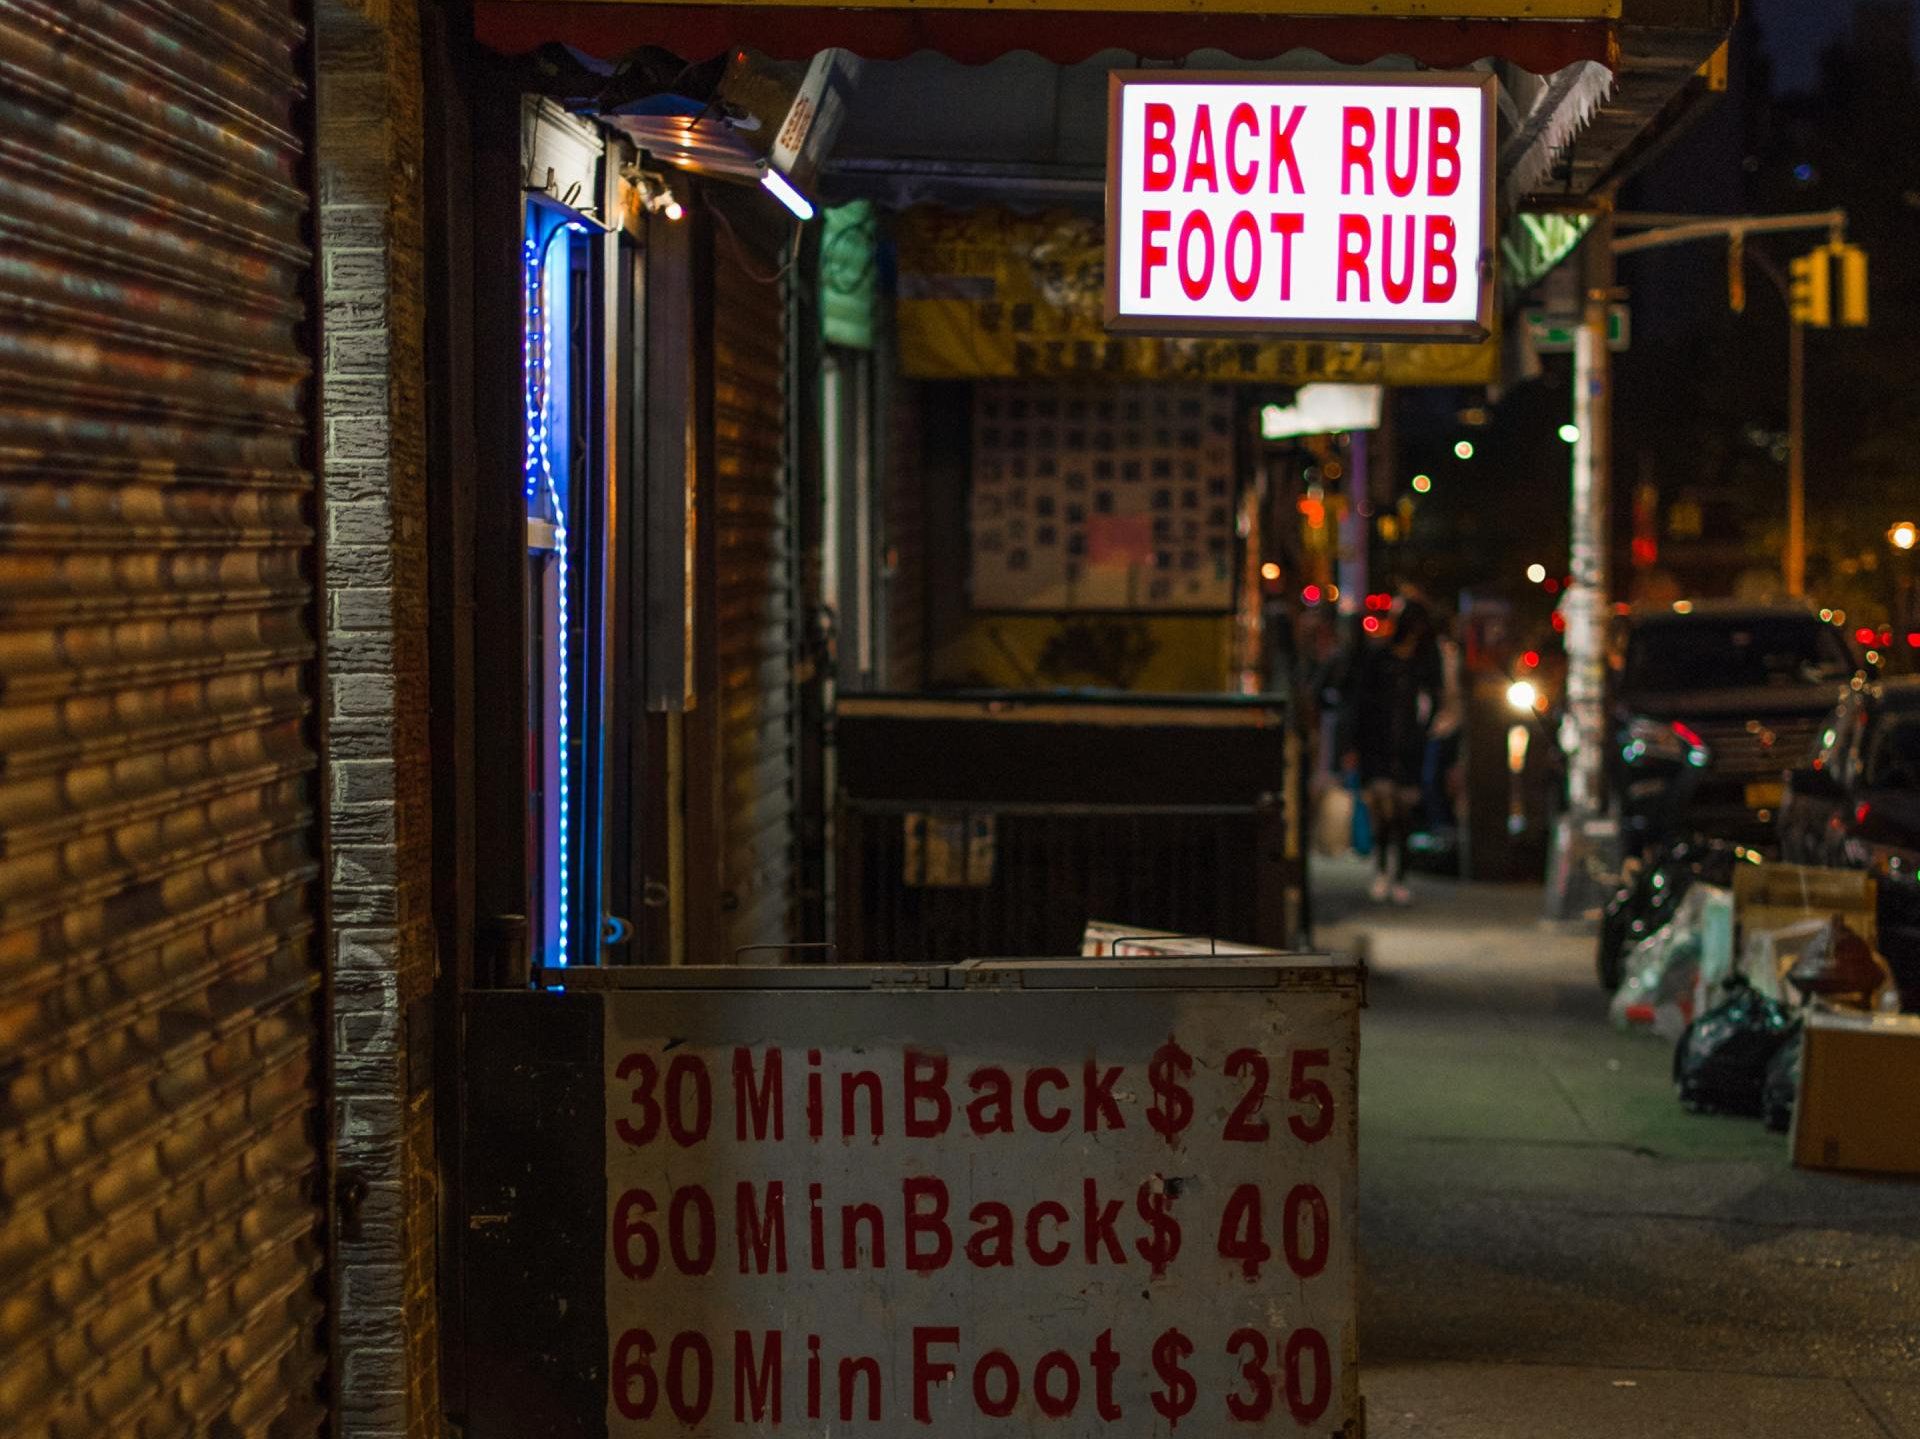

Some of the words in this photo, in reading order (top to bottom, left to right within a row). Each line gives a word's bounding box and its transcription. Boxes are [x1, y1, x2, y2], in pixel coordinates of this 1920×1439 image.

[1144, 103, 1306, 195] BACK
[1340, 107, 1461, 197] RUB
[1140, 209, 1305, 301] FOOT
[1337, 214, 1457, 303] RUB
[613, 1052, 713, 1147] 30
[732, 1046, 885, 1144] Min
[902, 1043, 1126, 1138] Back
[612, 1185, 717, 1281] 60
[736, 1180, 888, 1276] Min
[903, 1177, 1128, 1277] Back
[610, 1328, 714, 1424] 60
[733, 1329, 883, 1425] Min
[911, 1327, 1122, 1424] Foot
